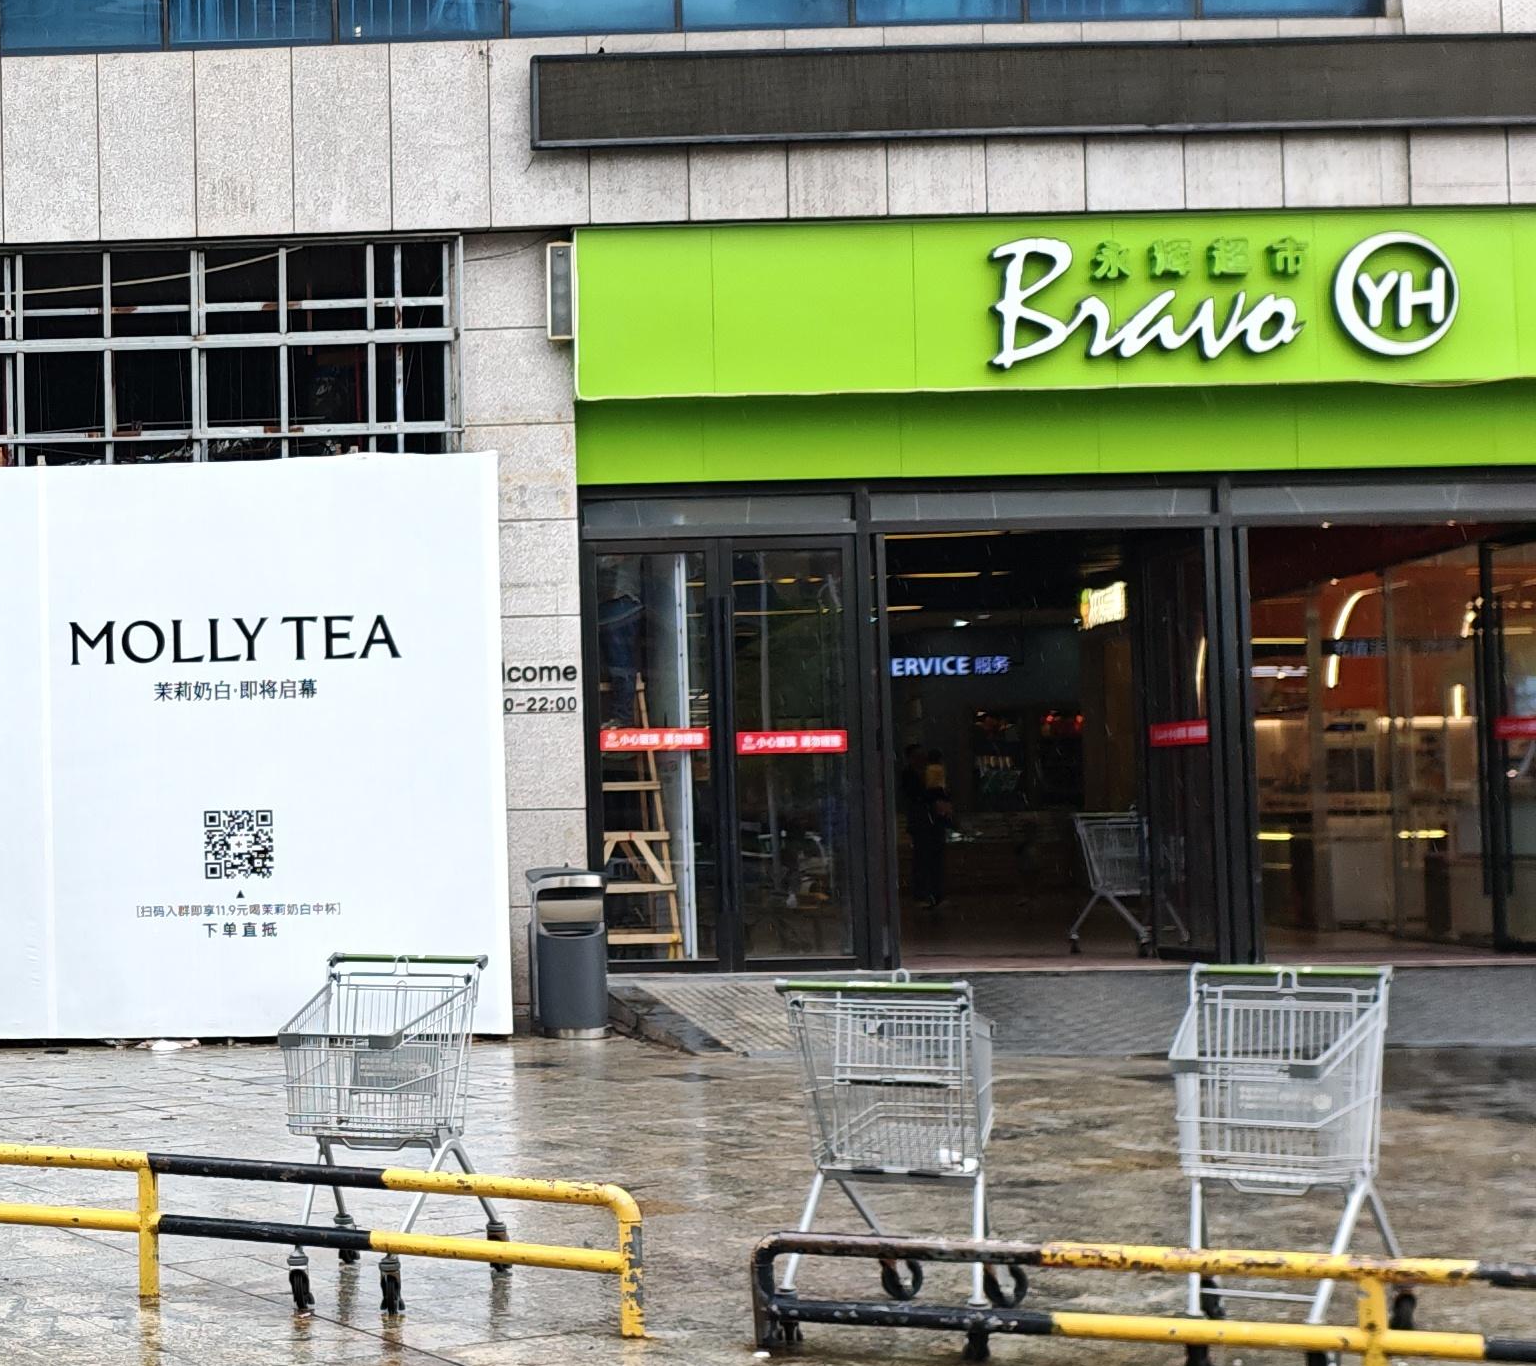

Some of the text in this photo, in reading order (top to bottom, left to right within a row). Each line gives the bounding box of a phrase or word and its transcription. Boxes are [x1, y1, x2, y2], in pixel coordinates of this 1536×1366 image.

[1091, 237, 1309, 281] 永辉超市
[989, 237, 1305, 369] Bravo
[1358, 266, 1446, 329] YH
[69, 614, 403, 666] MOLLY TEA
